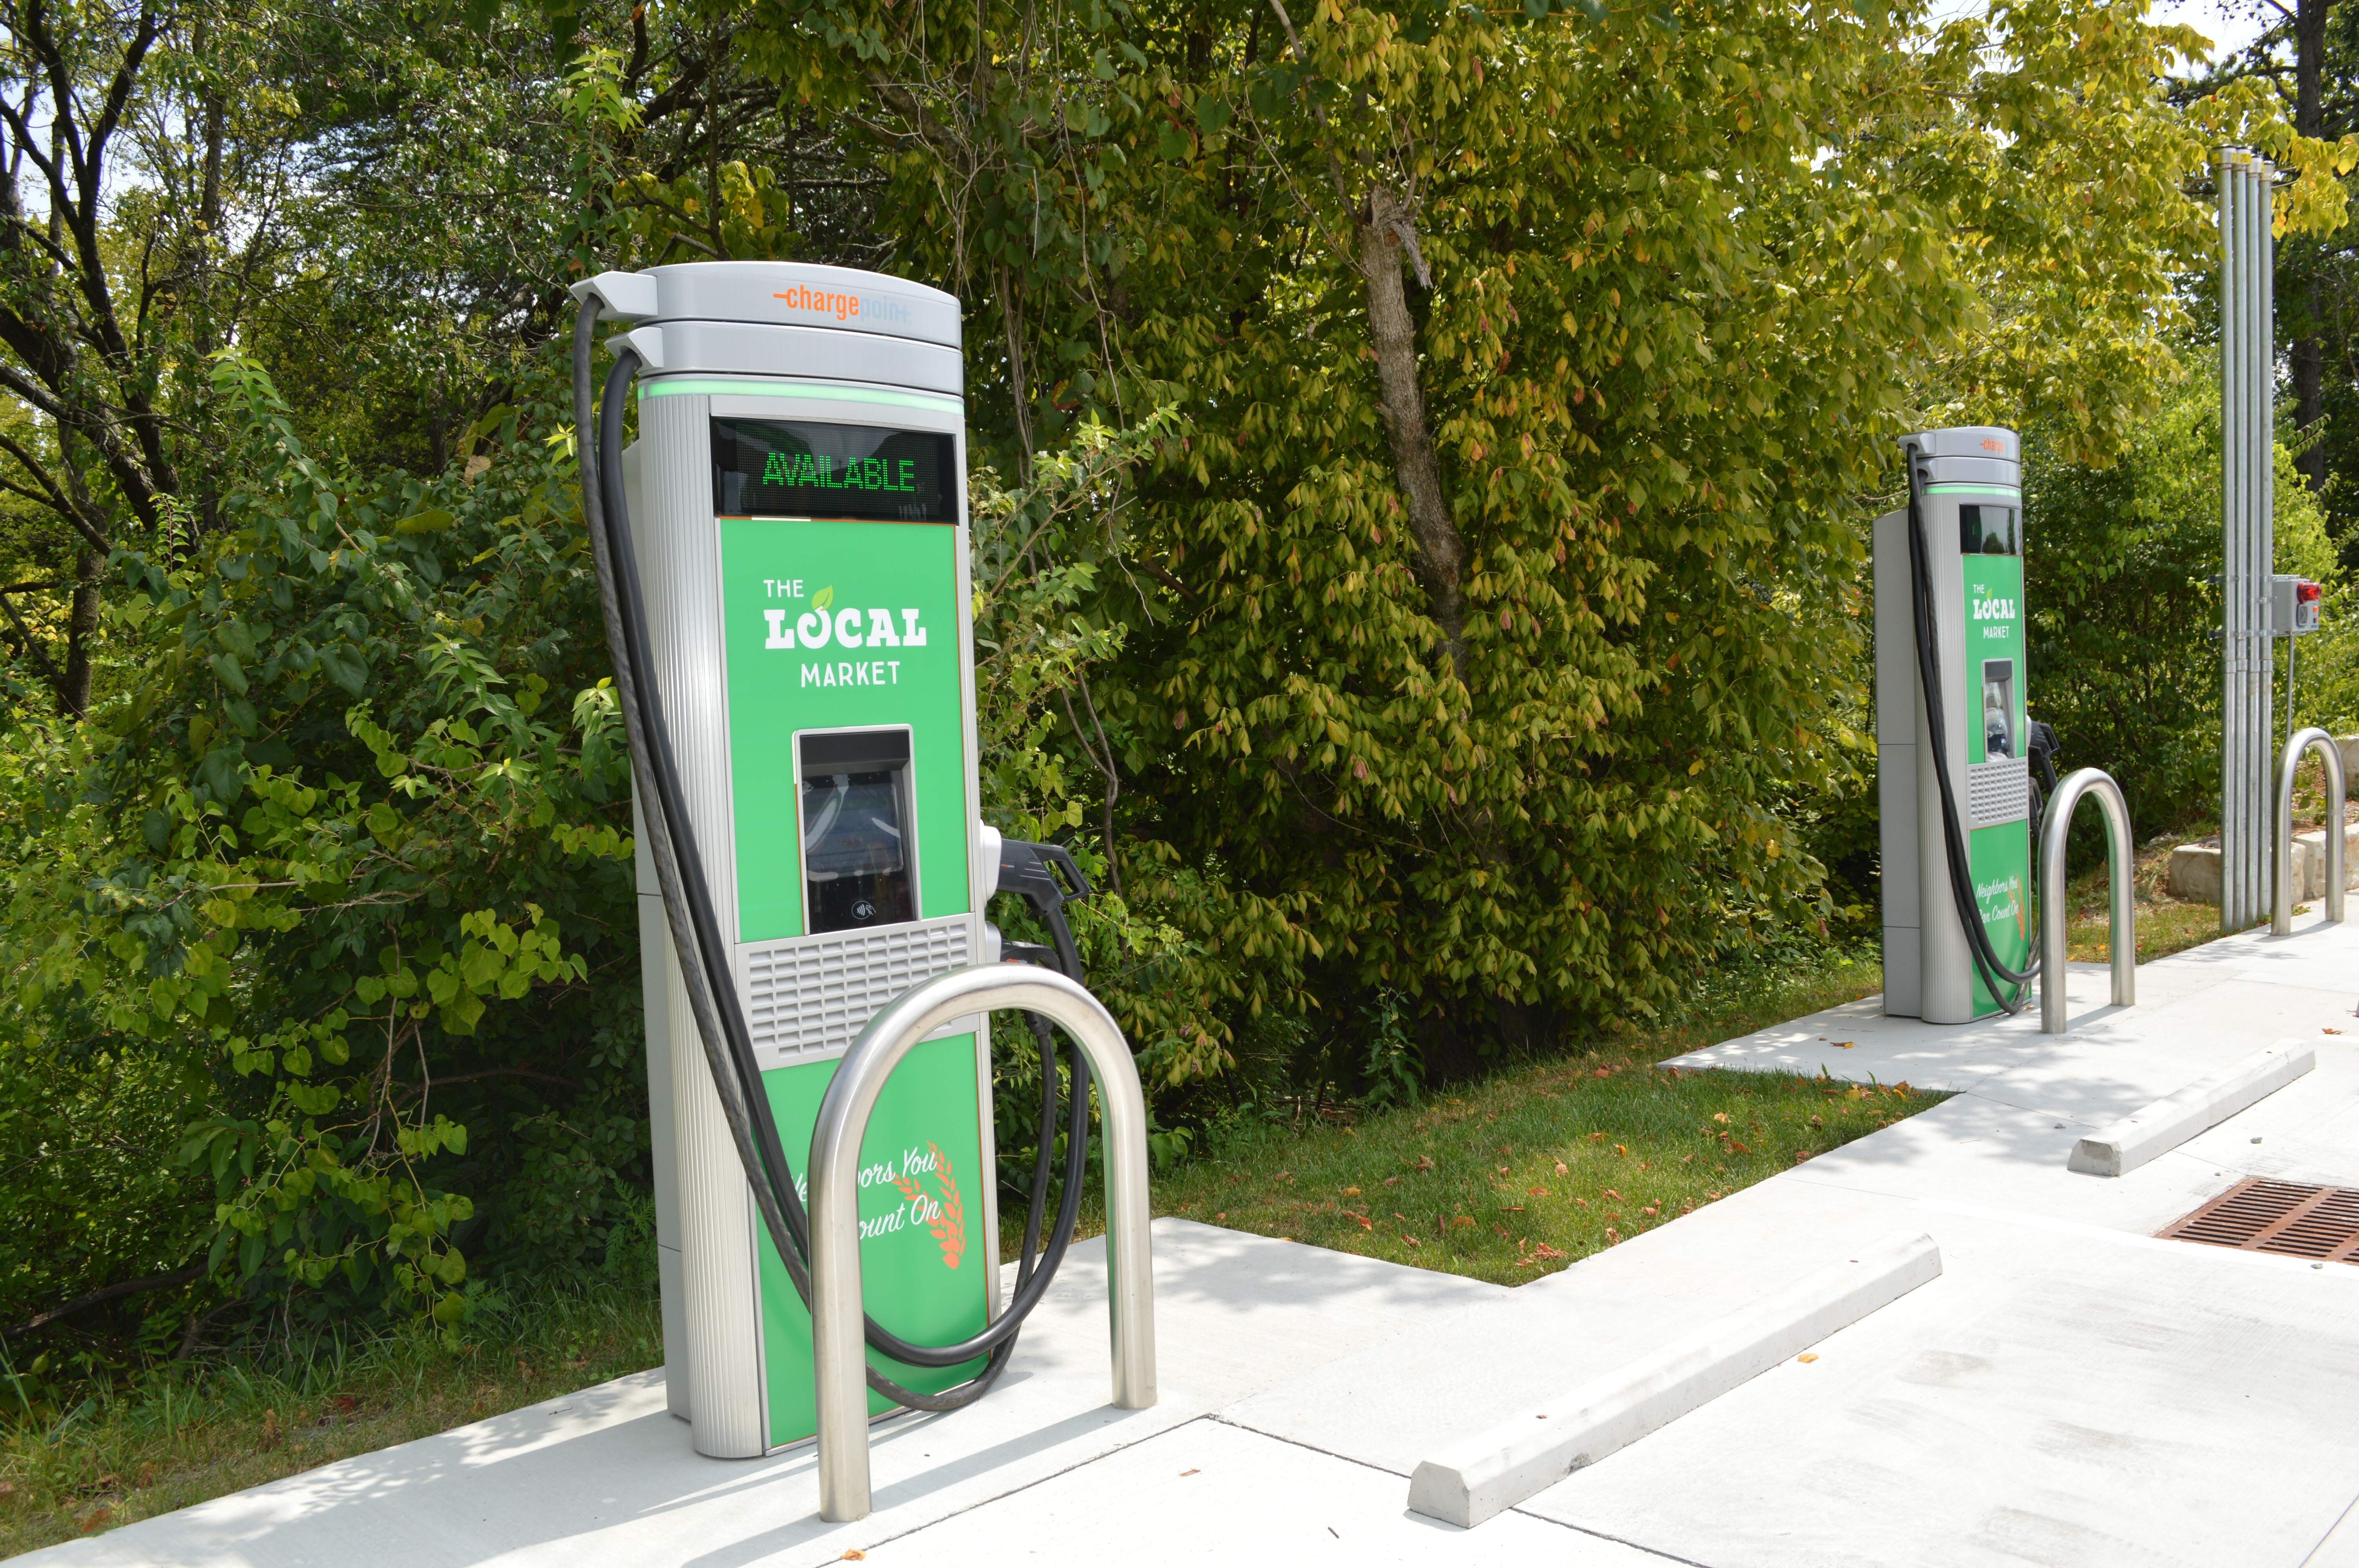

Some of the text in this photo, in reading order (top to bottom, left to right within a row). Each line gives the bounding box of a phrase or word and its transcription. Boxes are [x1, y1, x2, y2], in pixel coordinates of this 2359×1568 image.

[773, 284, 912, 325] chargepoint
[763, 452, 915, 492] AVAILABLE
[763, 579, 804, 598] THE
[1973, 584, 1985, 593] THE
[1973, 598, 2015, 619] LOCAL
[763, 606, 927, 650] LOCAL
[1983, 626, 2009, 639] MARKET
[801, 661, 900, 688] MARKET
[1976, 875, 2018, 904] Neighbors You
[1992, 903, 2011, 921] Count
[2011, 900, 2019, 916] On
[903, 1147, 938, 1178] You
[859, 1194, 941, 1240] ount On
